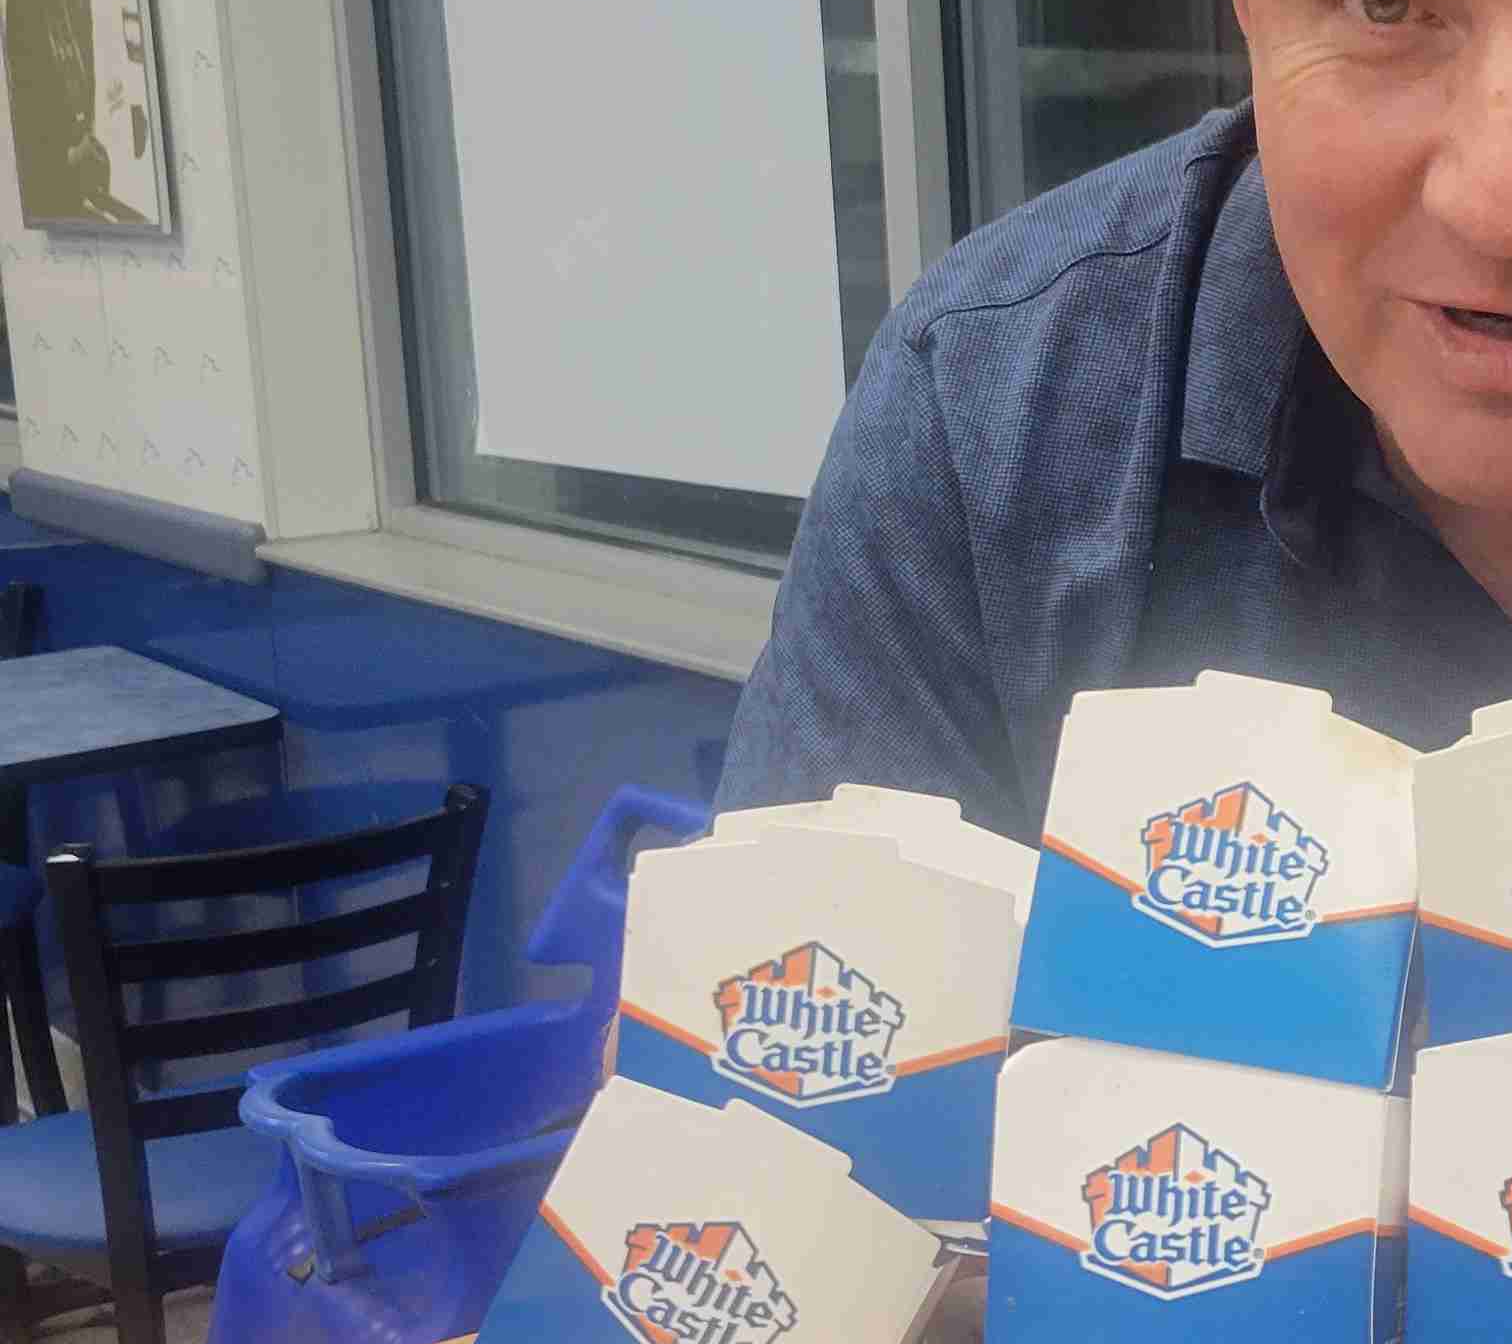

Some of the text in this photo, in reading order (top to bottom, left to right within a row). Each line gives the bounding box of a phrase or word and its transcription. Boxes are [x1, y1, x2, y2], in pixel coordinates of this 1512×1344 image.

[1168, 820, 1307, 882] White
[1146, 864, 1303, 926] Castle
[738, 983, 882, 1040] White
[726, 1029, 883, 1081] Castle
[1109, 1173, 1246, 1226] White
[1094, 1220, 1251, 1268] Castle
[643, 1231, 773, 1328] White
